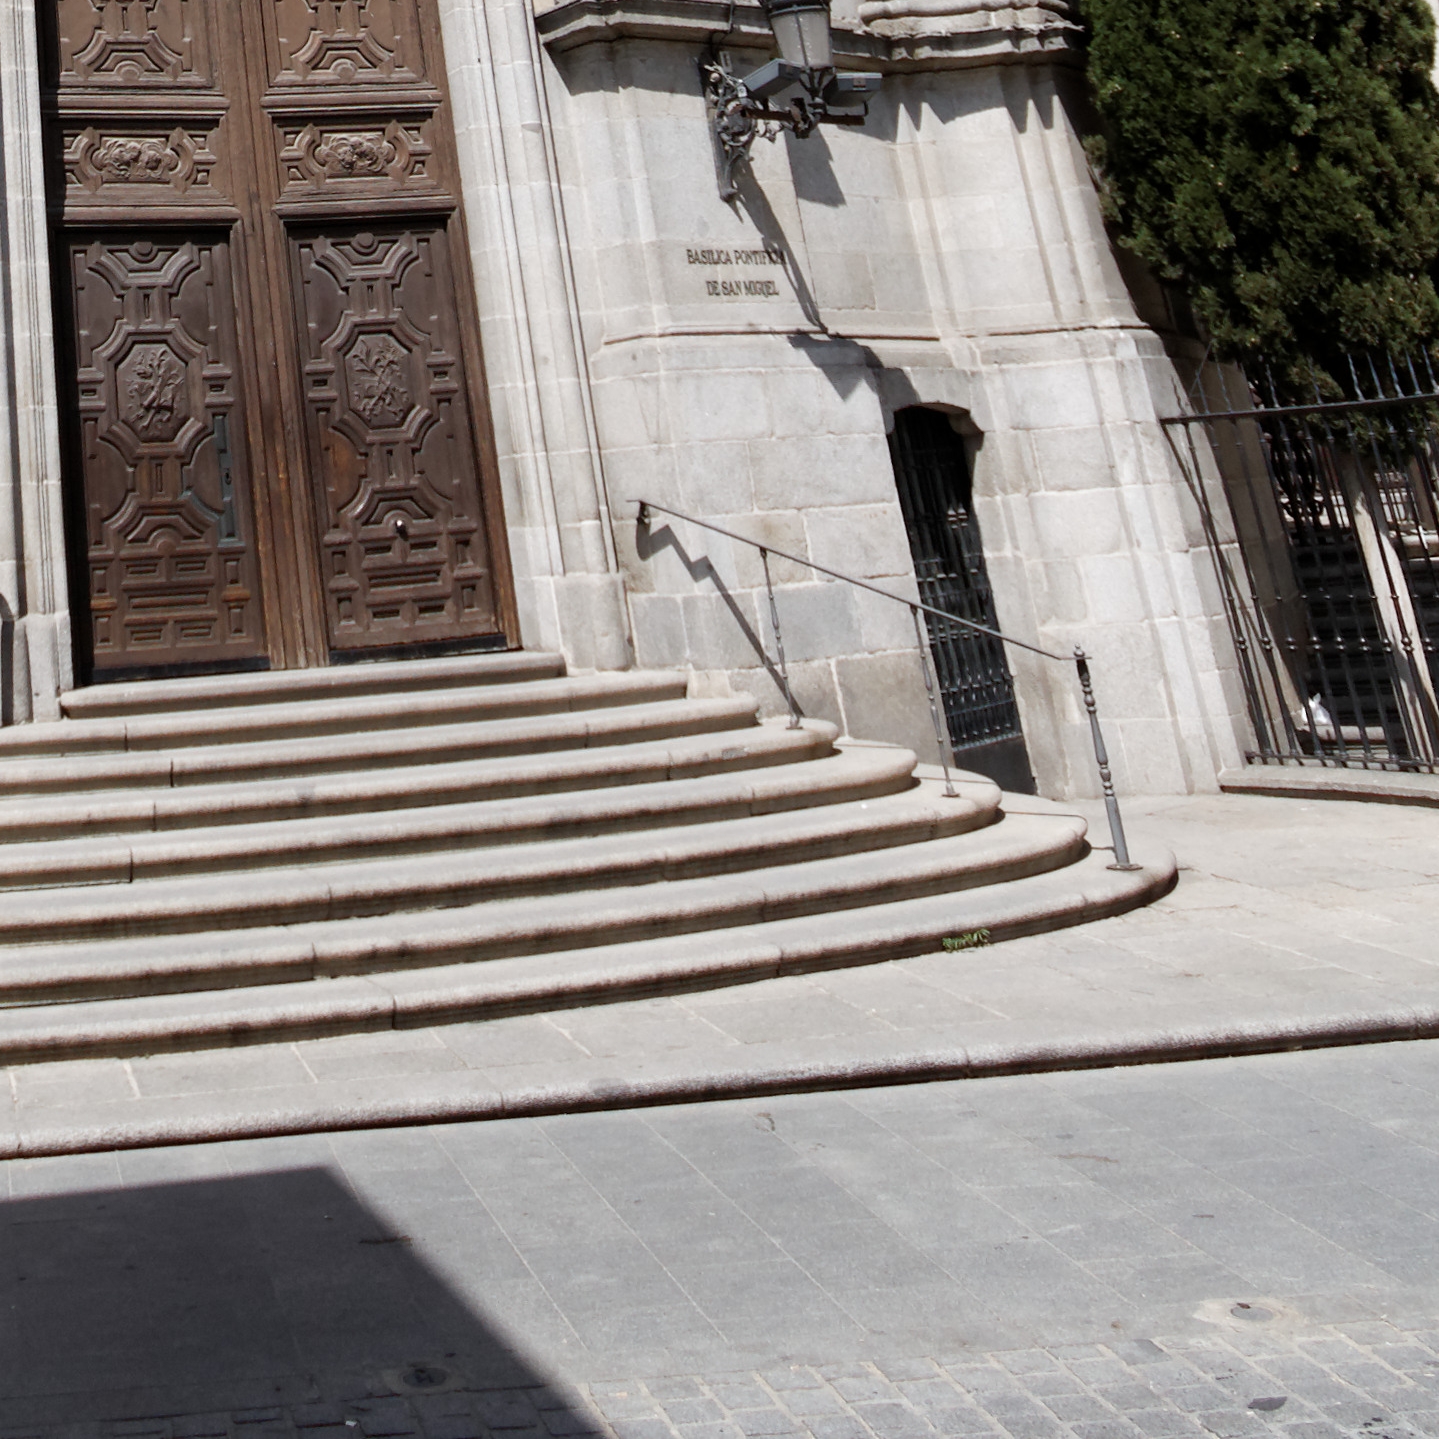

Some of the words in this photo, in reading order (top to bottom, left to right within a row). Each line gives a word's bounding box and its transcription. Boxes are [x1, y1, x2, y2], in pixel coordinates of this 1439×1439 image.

[686, 248, 733, 265] BASILICA
[705, 280, 720, 296] DE
[721, 280, 743, 296] SAN
